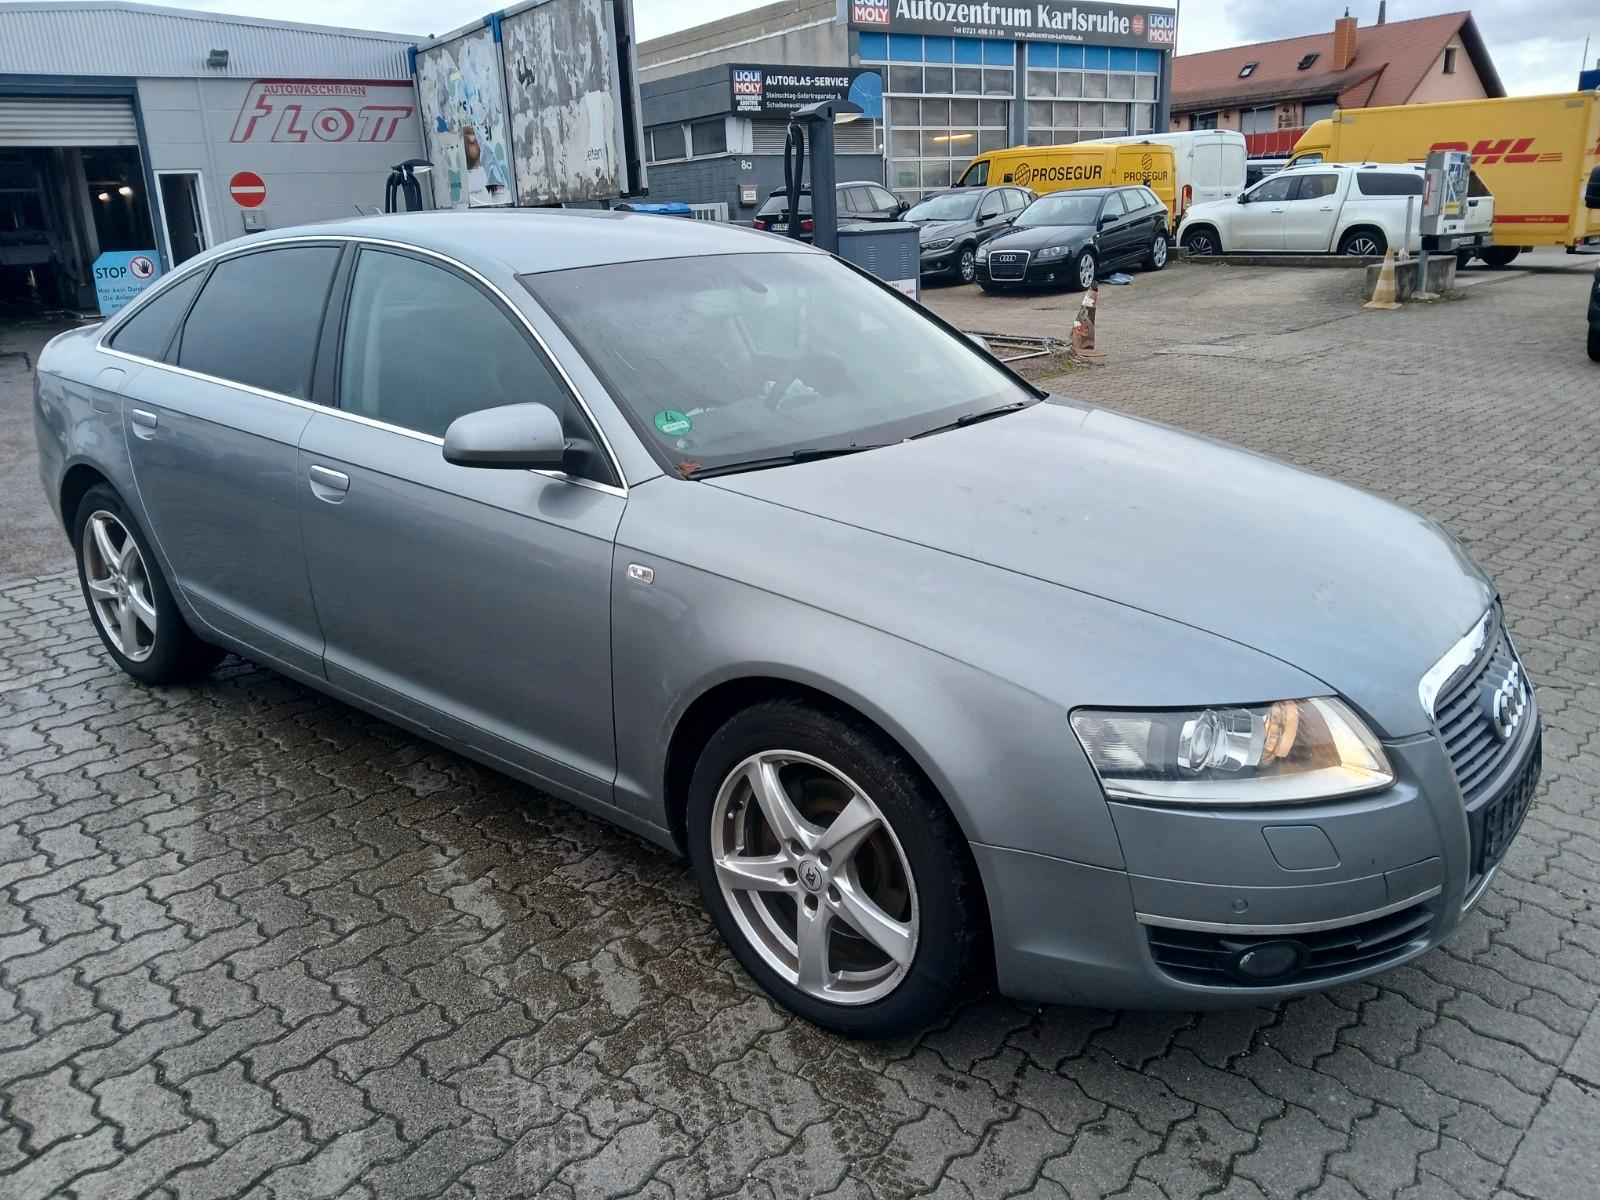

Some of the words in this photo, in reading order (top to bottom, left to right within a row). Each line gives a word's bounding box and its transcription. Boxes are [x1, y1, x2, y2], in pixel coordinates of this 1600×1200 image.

[854, 7, 889, 22] MOLY
[895, 0, 1032, 27] Autozentrum
[1037, 4, 1130, 35] Karlsruhe
[1150, 16, 1175, 29] LIQUI
[1149, 29, 1175, 42] MOLY
[735, 71, 761, 82] LIQUI
[765, 75, 849, 87] AUTOGLAS-SERVICE
[263, 85, 366, 96] AUTOWASCHBAHN
[735, 82, 761, 94] MOLY
[229, 79, 414, 143] FLOTT
[585, 148, 603, 162] eten
[741, 159, 752, 170] 8a
[1031, 165, 1102, 181] PROSEGUR
[1123, 170, 1169, 182] PROSEGUR
[95, 266, 127, 279] STOP
